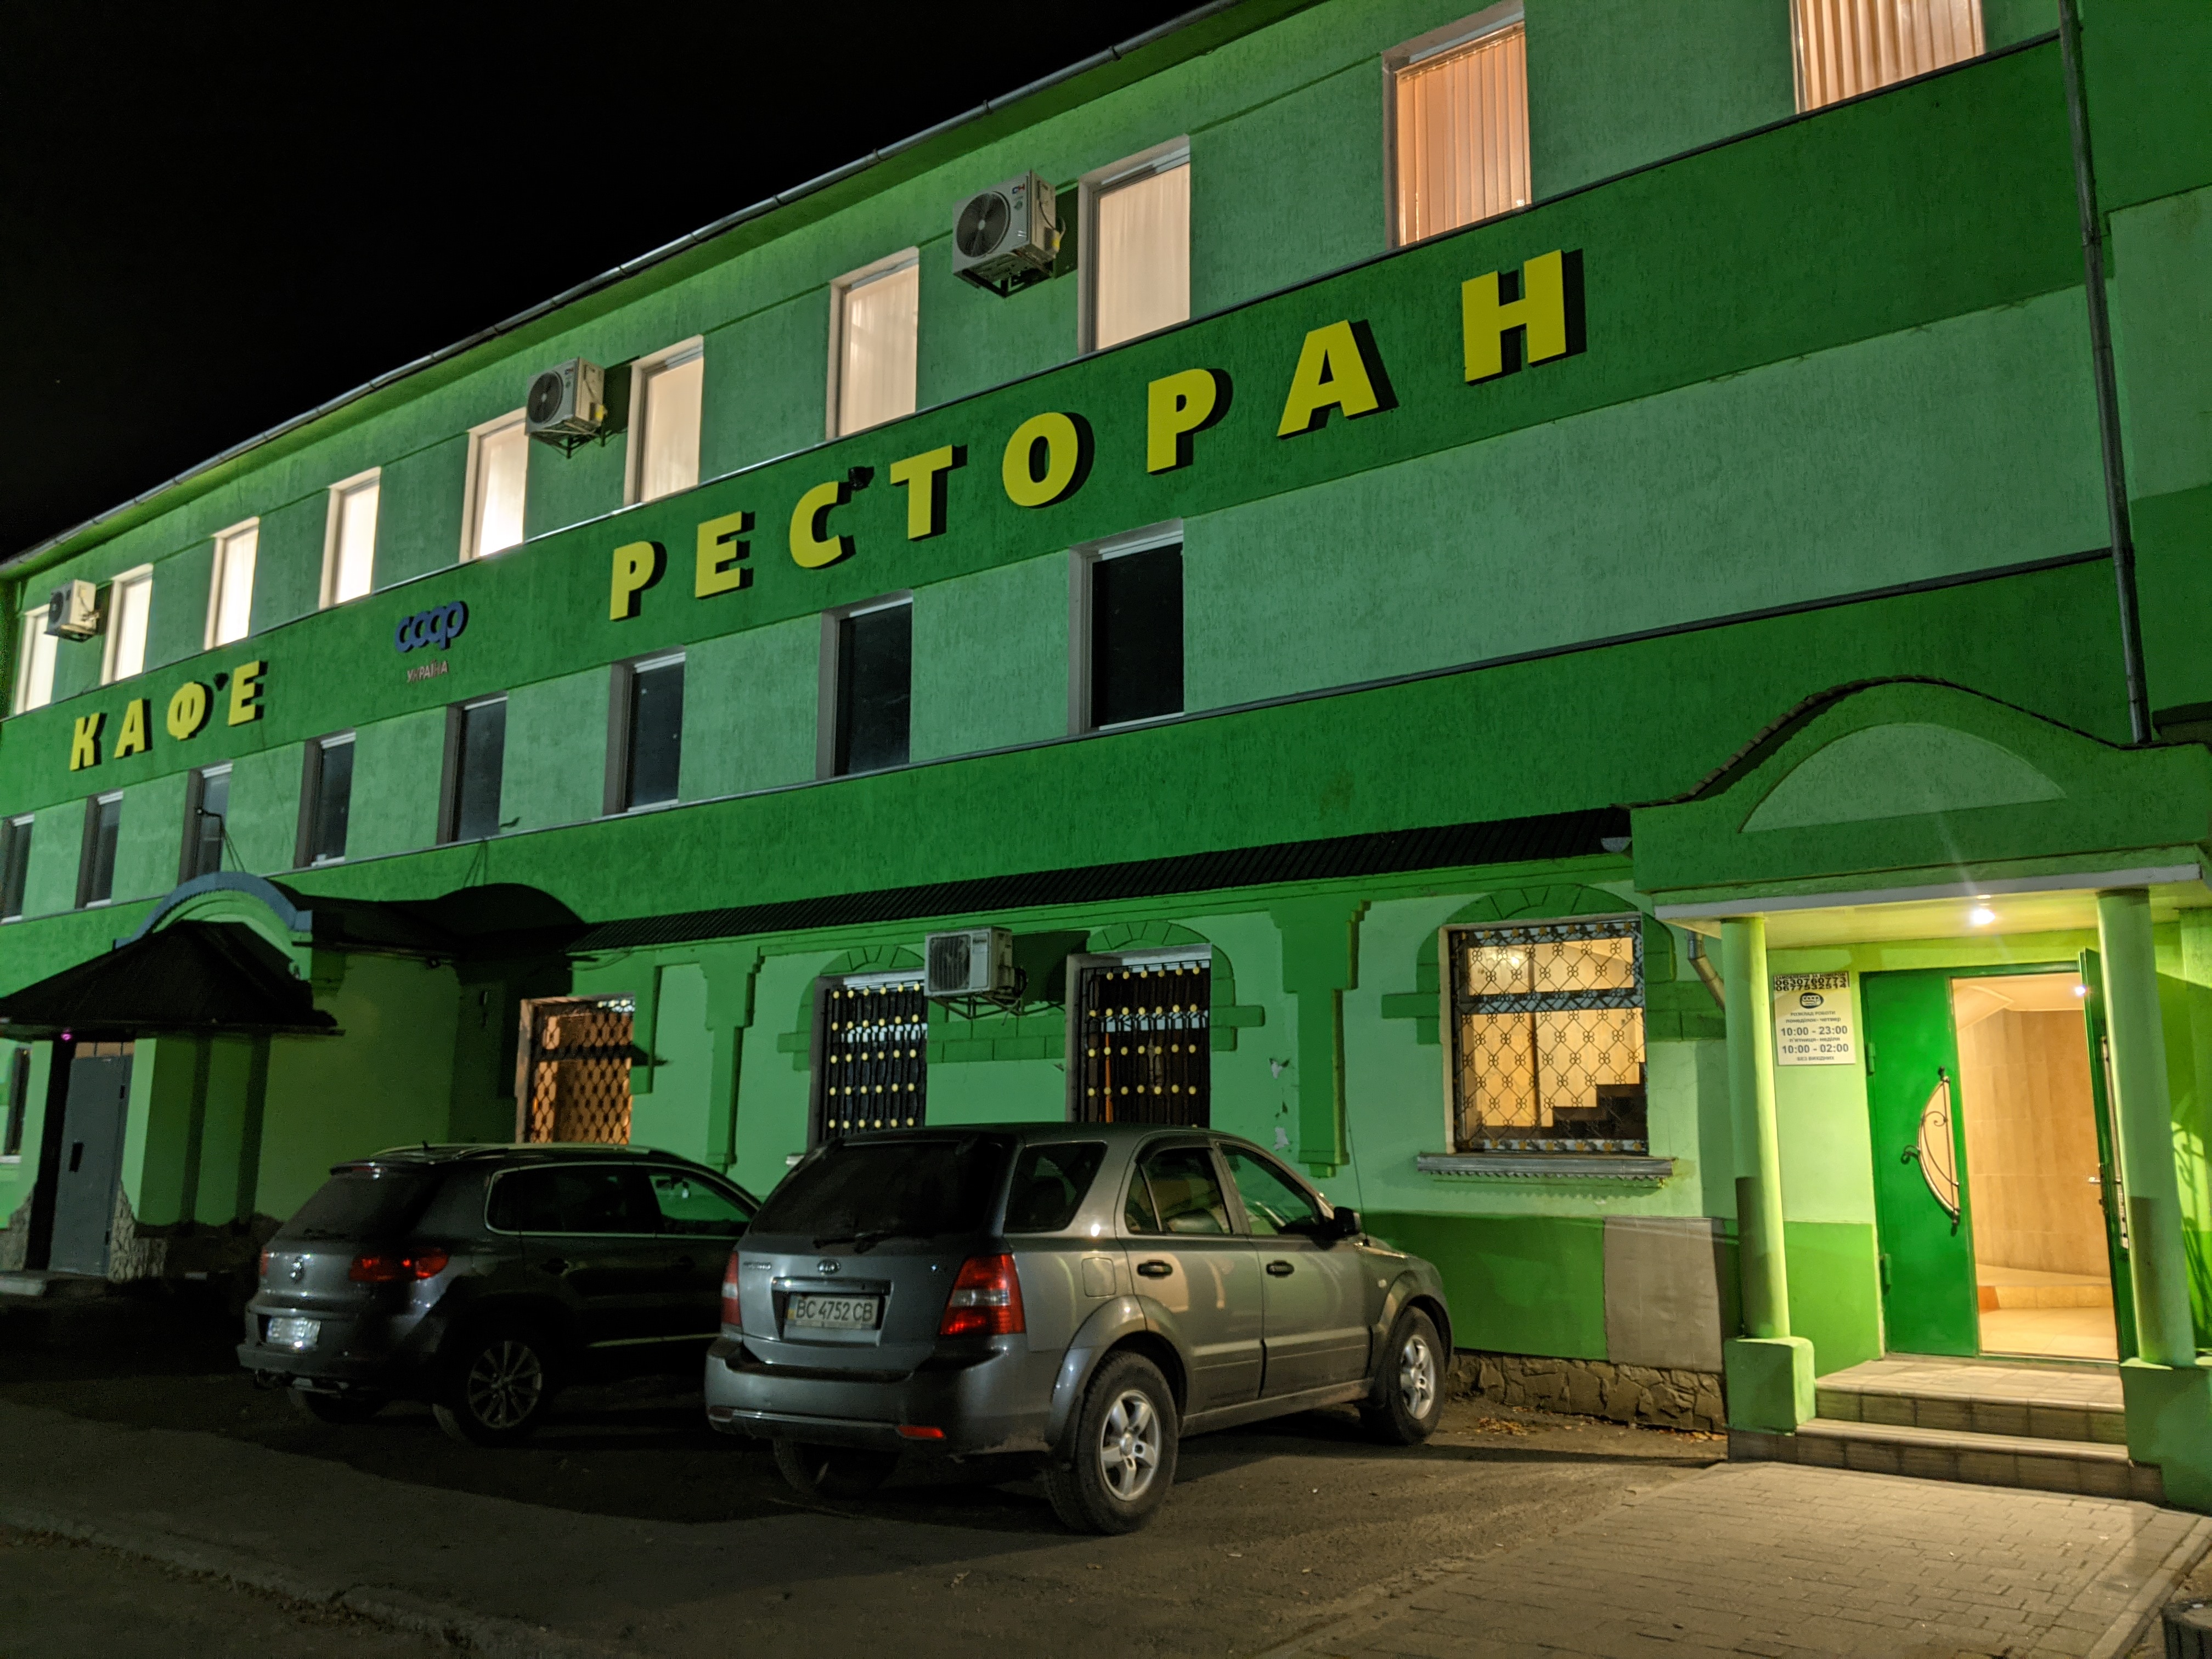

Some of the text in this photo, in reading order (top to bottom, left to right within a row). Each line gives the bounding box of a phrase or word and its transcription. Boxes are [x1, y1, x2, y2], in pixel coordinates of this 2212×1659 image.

[610, 250, 1569, 620] РЕСТОРАН
[70, 661, 266, 771] КАФЕ
[1776, 977, 1847, 986] 0630760773
[1781, 1026, 1809, 1036] 10:00
[1819, 1025, 1848, 1035] 23:00
[1782, 1045, 1810, 1053] 10:00
[1820, 1043, 1849, 1053] 02:00
[797, 1299, 873, 1322] BC 4752 CB
